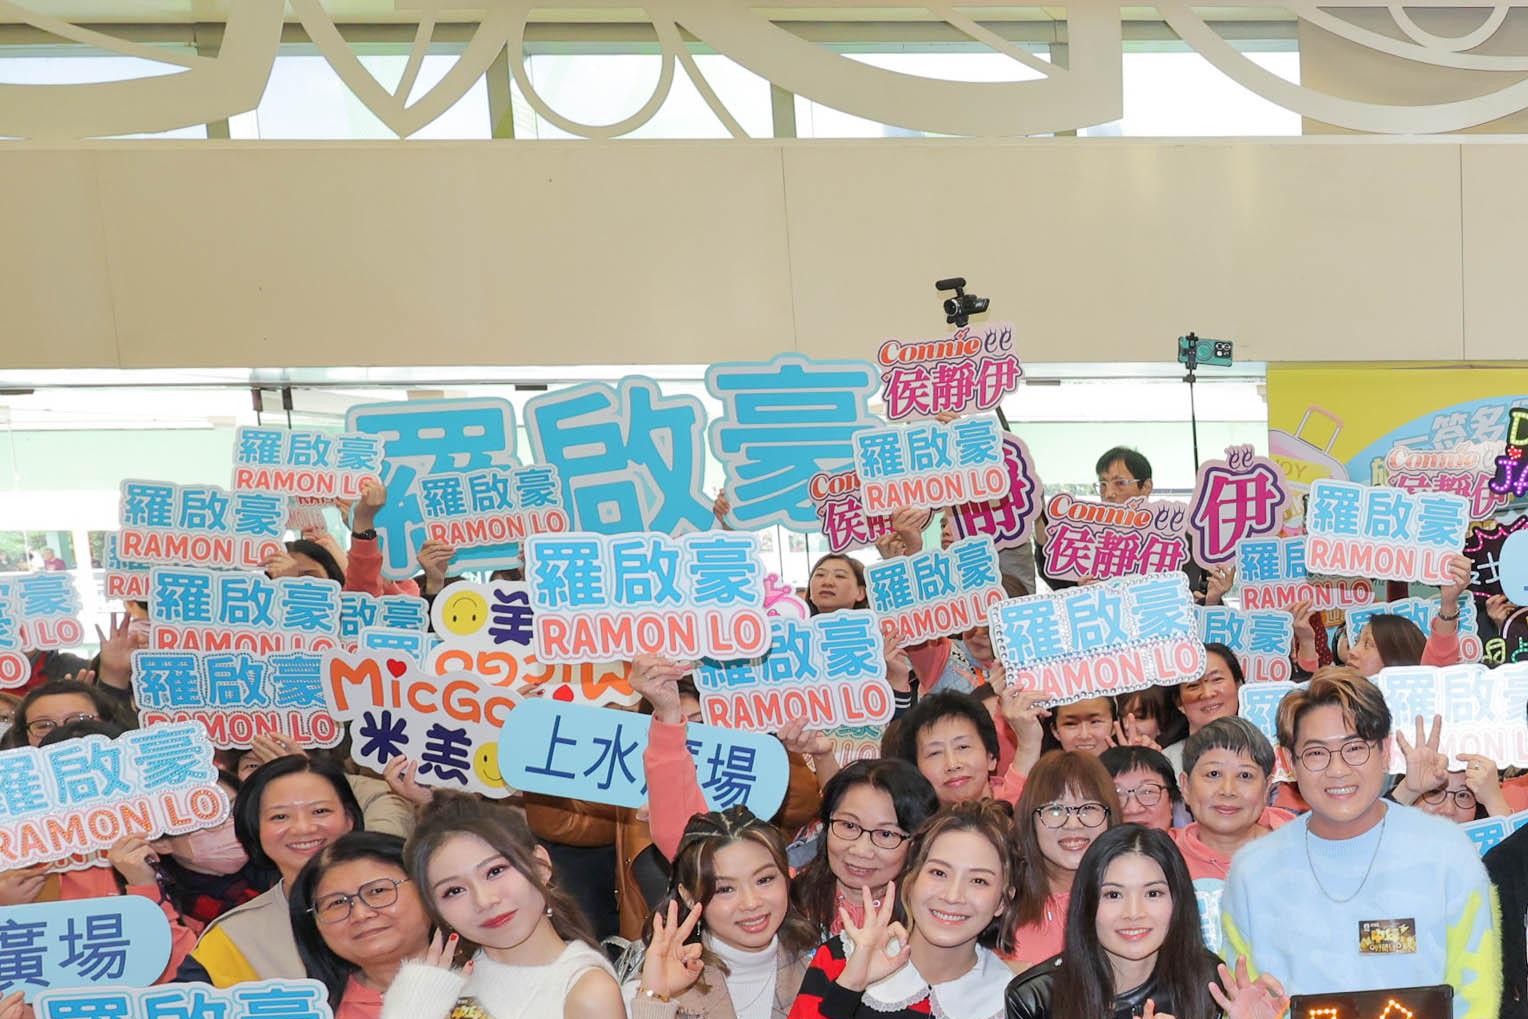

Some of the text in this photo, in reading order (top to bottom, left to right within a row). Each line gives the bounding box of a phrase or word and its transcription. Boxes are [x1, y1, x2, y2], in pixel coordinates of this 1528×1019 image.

[881, 331, 982, 365] Connie
[887, 354, 1021, 420] 侯靜伊
[237, 429, 381, 471] 羅啟豪
[859, 421, 999, 478] 羅啟豪
[235, 468, 333, 494] RAMON
[421, 468, 559, 518] 羅啟豪
[866, 468, 1005, 513] RAMON LO
[125, 481, 283, 537] 羅啟豪
[430, 511, 564, 546] RAMON LO
[1049, 495, 1152, 529] Connie
[1312, 483, 1466, 550] 羅啟豪
[123, 532, 282, 565] RAMON LO
[1046, 525, 1187, 580] 侯靜伊
[1310, 538, 1414, 583] RAMON
[536, 540, 756, 606] 羅啟豪
[870, 540, 996, 613] 羅啟豪
[1243, 580, 1372, 611] RAMON LO
[155, 572, 337, 632] 羅啟豪
[881, 600, 972, 641] RAMON
[1000, 577, 1191, 661] 羅啟豪
[542, 612, 762, 656] RAMON LO
[139, 655, 322, 706] 羅啟豪
[330, 657, 516, 729] MicGo
[1015, 640, 1200, 700] RAMON LO
[291, 711, 336, 743] LO
[707, 684, 888, 731] RAMON LO
[525, 714, 758, 809] 上水場
[164, 787, 220, 829] LO
